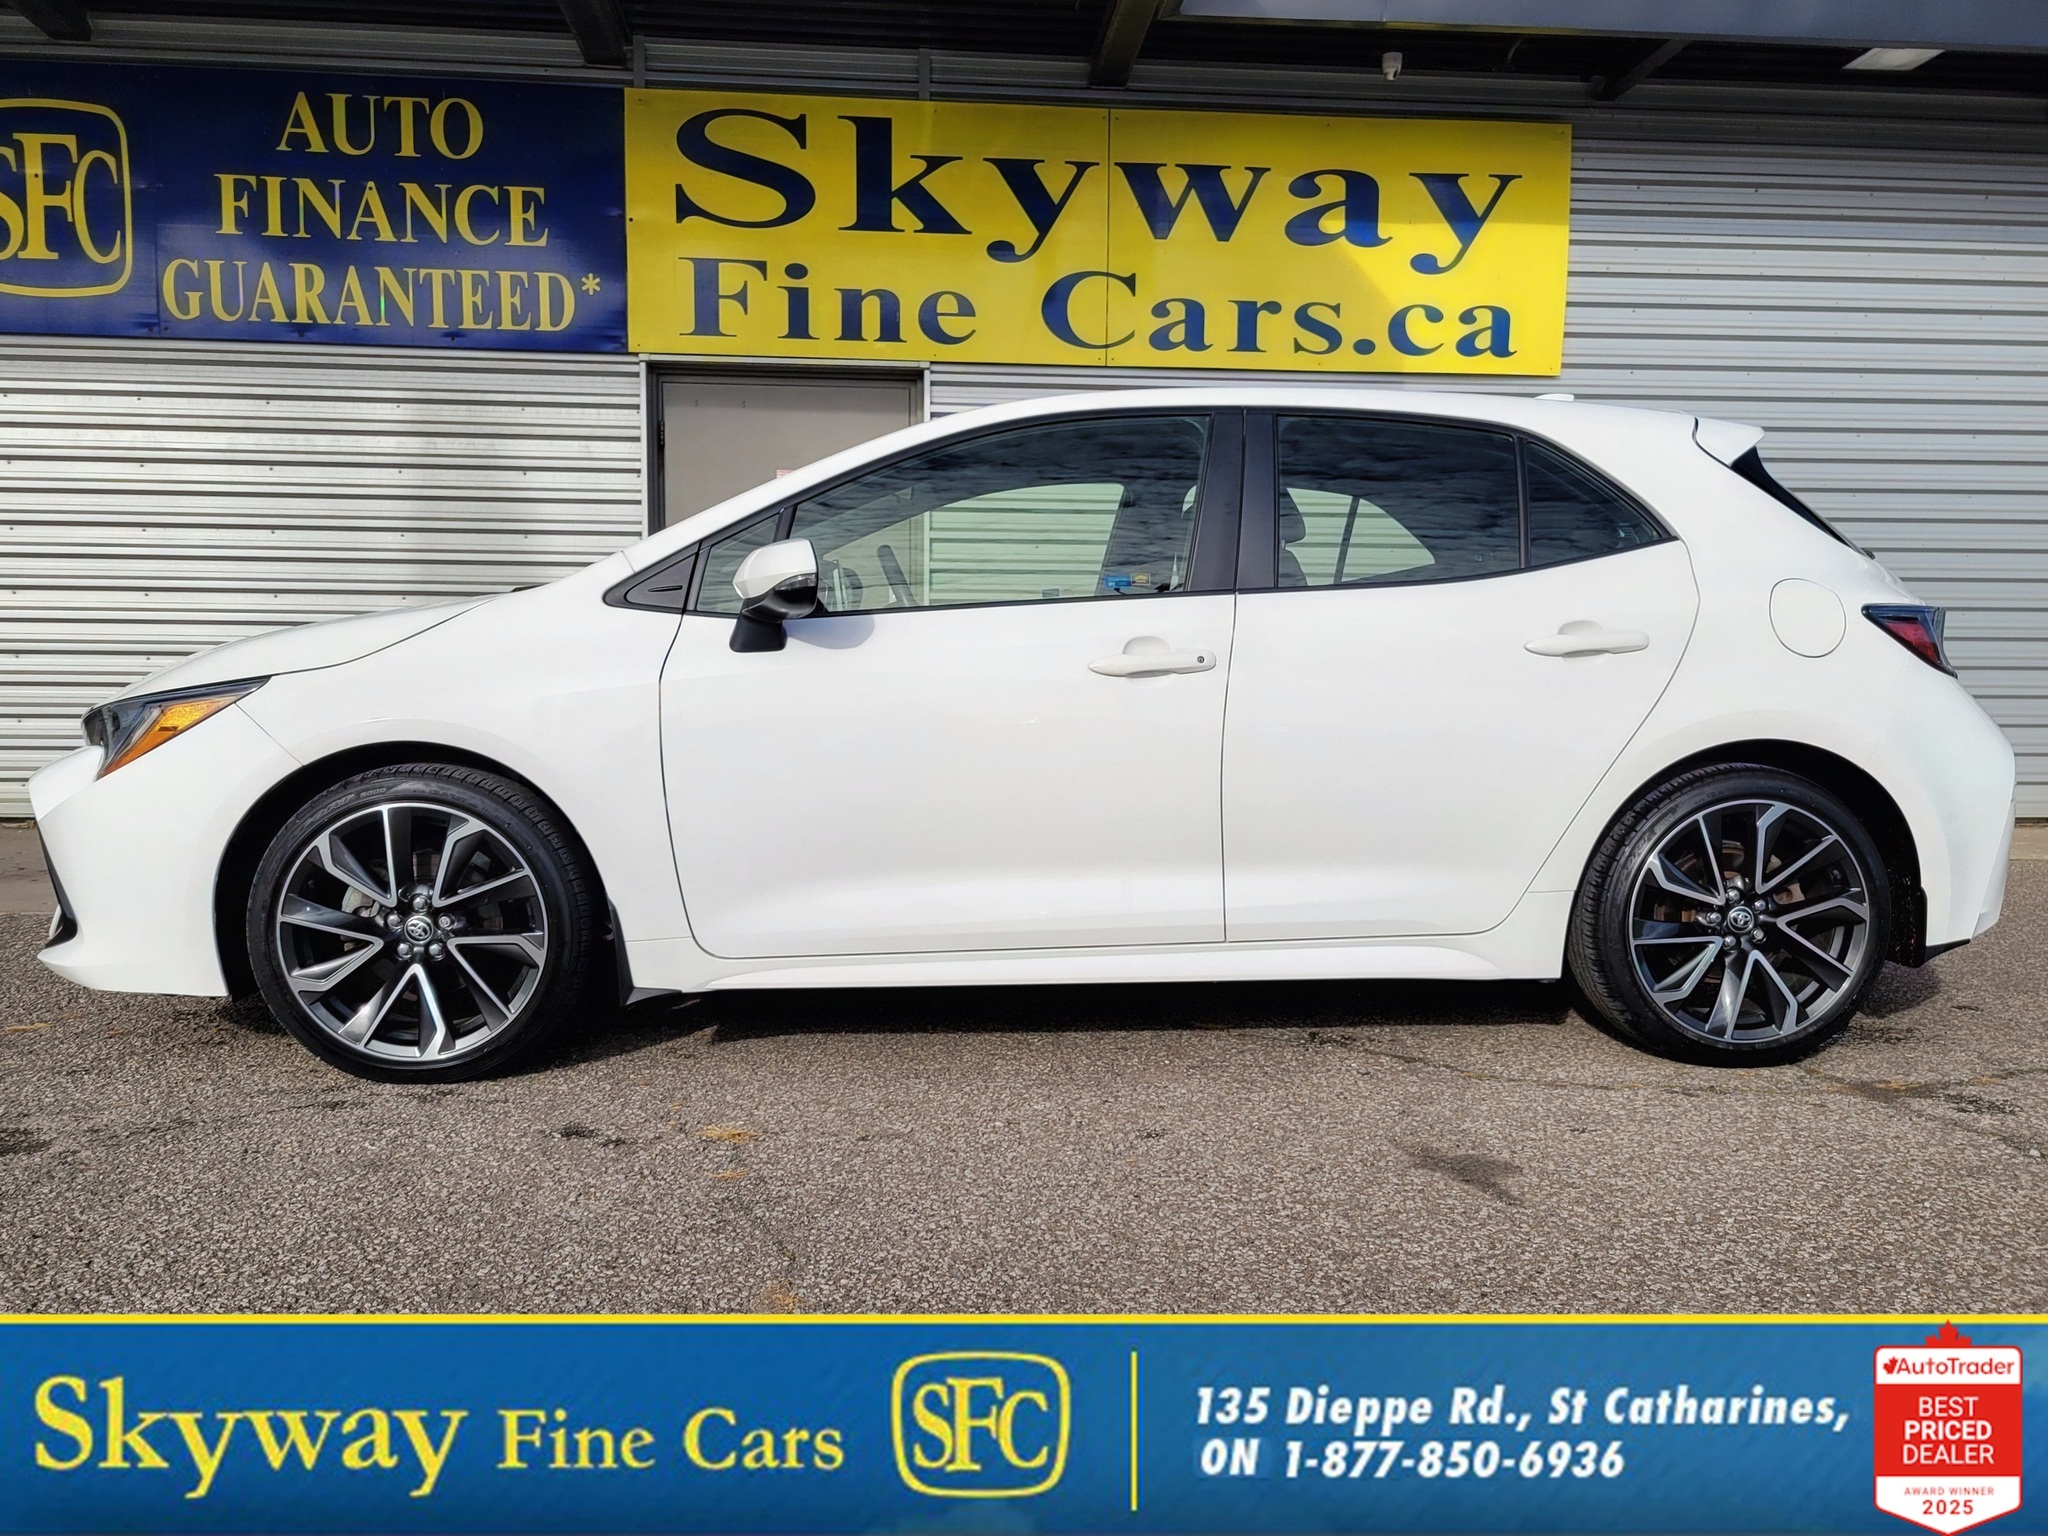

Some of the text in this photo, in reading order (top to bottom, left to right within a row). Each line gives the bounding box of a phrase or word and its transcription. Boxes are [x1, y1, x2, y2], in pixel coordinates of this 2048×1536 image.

[277, 91, 484, 159] AUTO
[215, 174, 549, 247] FINANCE
[674, 107, 1523, 274] Skyway
[679, 257, 1516, 358] Fine Cars.ca
